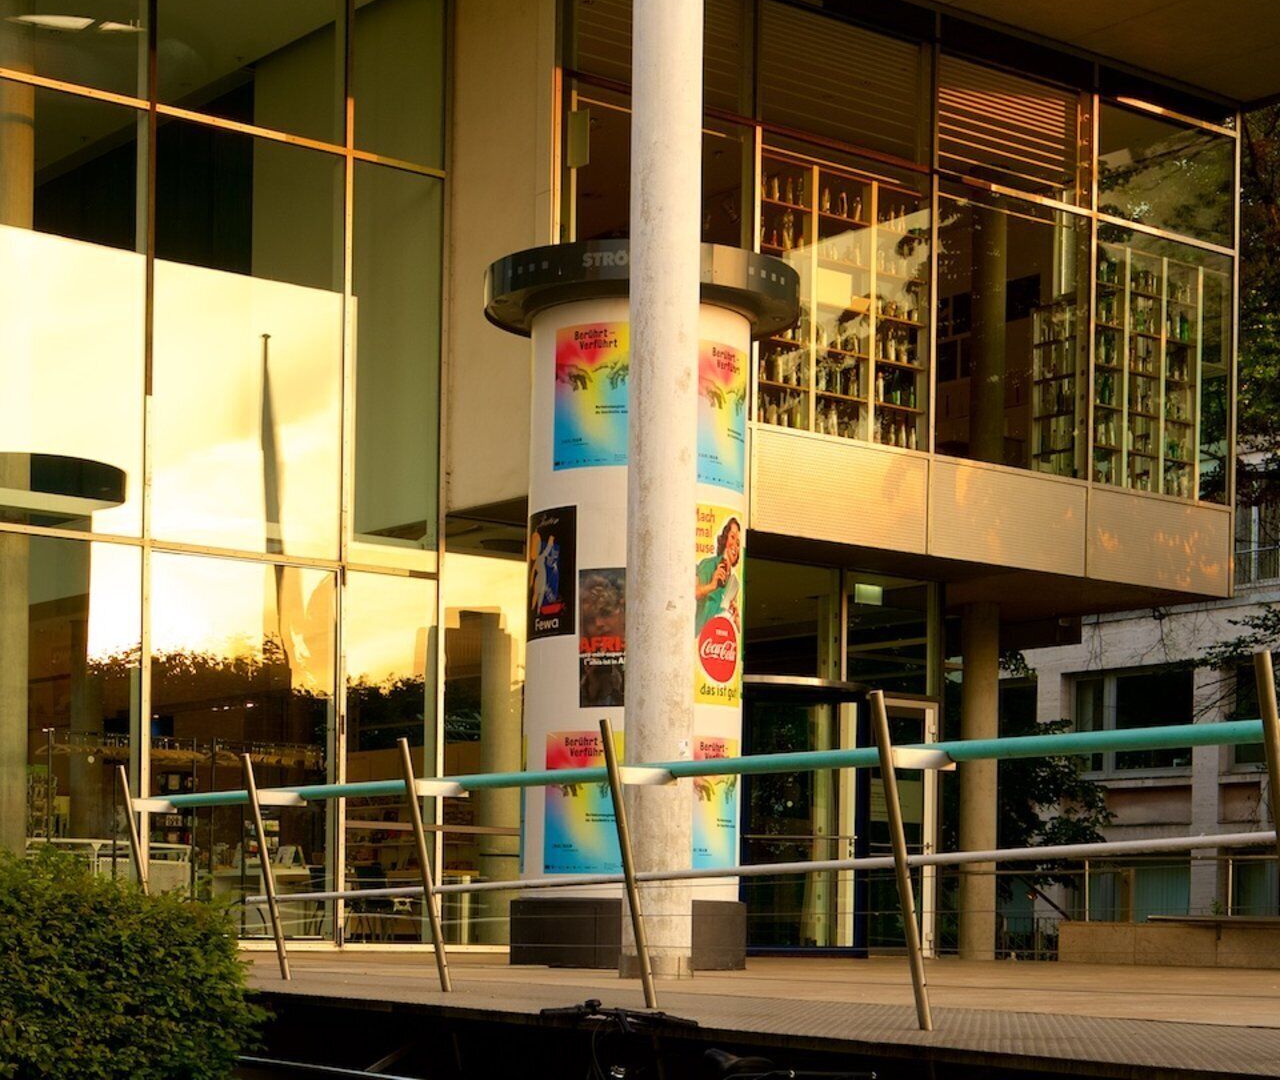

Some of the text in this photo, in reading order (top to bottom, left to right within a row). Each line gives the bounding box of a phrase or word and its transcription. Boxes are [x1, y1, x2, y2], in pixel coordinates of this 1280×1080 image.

[582, 249, 629, 267] STRÖ
[696, 524, 713, 537] mal
[696, 542, 715, 554] ause
[700, 683, 716, 696] das
[716, 685, 727, 697] ist
[570, 747, 604, 757] Verführ
